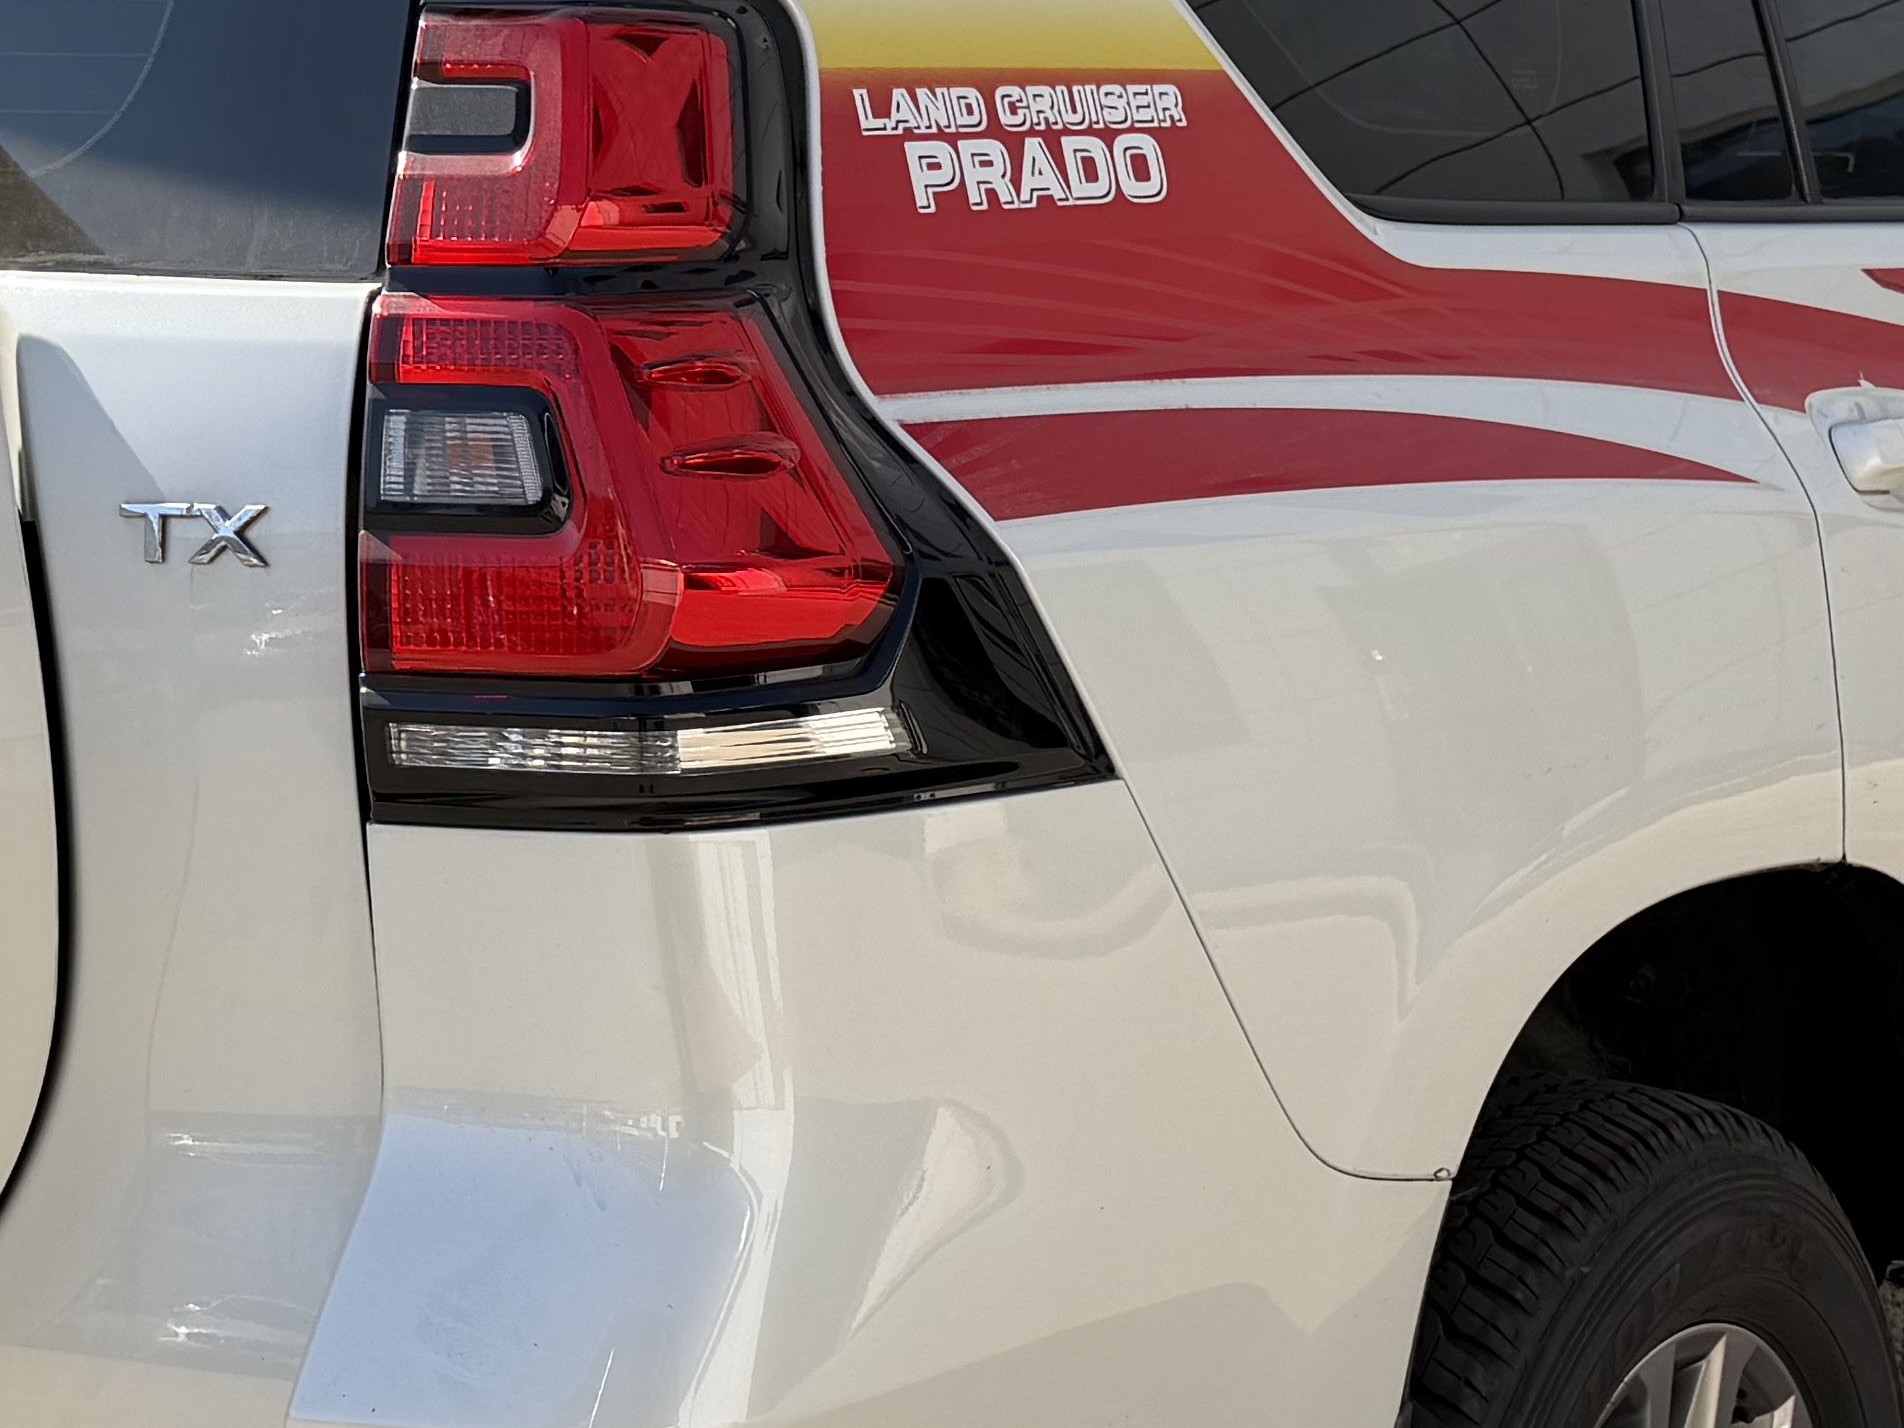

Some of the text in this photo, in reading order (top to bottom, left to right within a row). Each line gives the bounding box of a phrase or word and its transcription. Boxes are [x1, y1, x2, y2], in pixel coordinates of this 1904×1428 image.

[853, 84, 1187, 135] LAND CRUISER
[904, 134, 1168, 213] PRADO
[119, 502, 270, 567] TX
